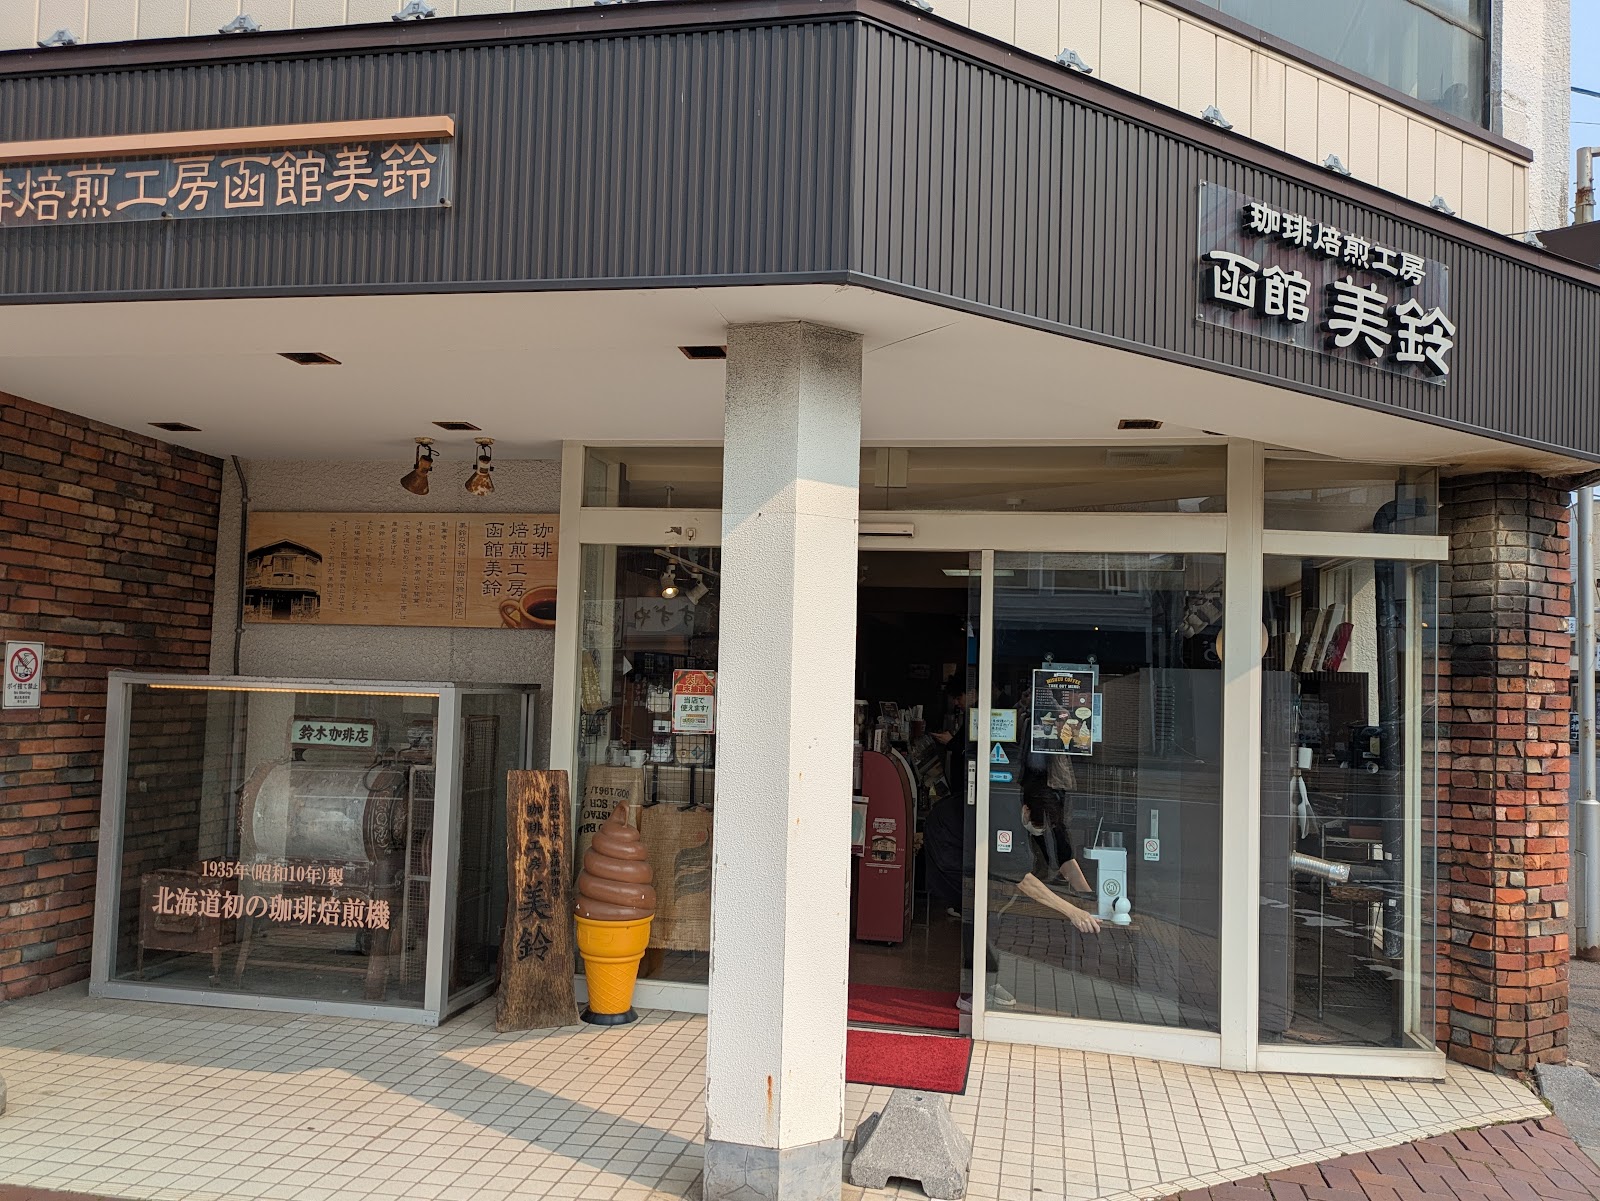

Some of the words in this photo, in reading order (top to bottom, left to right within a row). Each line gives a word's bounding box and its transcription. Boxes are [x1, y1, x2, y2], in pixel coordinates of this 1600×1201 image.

[1247, 201, 1426, 286] 珈琲焙煎工房
[1207, 250, 1311, 323] 函館
[1326, 275, 1456, 376] 美鈴
[481, 521, 505, 598] 函館美鈴
[506, 521, 529, 597] 焙煎工房
[532, 522, 554, 559] 珈琲
[683, 696, 706, 704] 当店で
[298, 724, 369, 744] 鈴木珈琲店
[201, 860, 344, 887] 1935年(昭和10年)製
[151, 886, 391, 930] 北海道初の珈琲焙煎機
